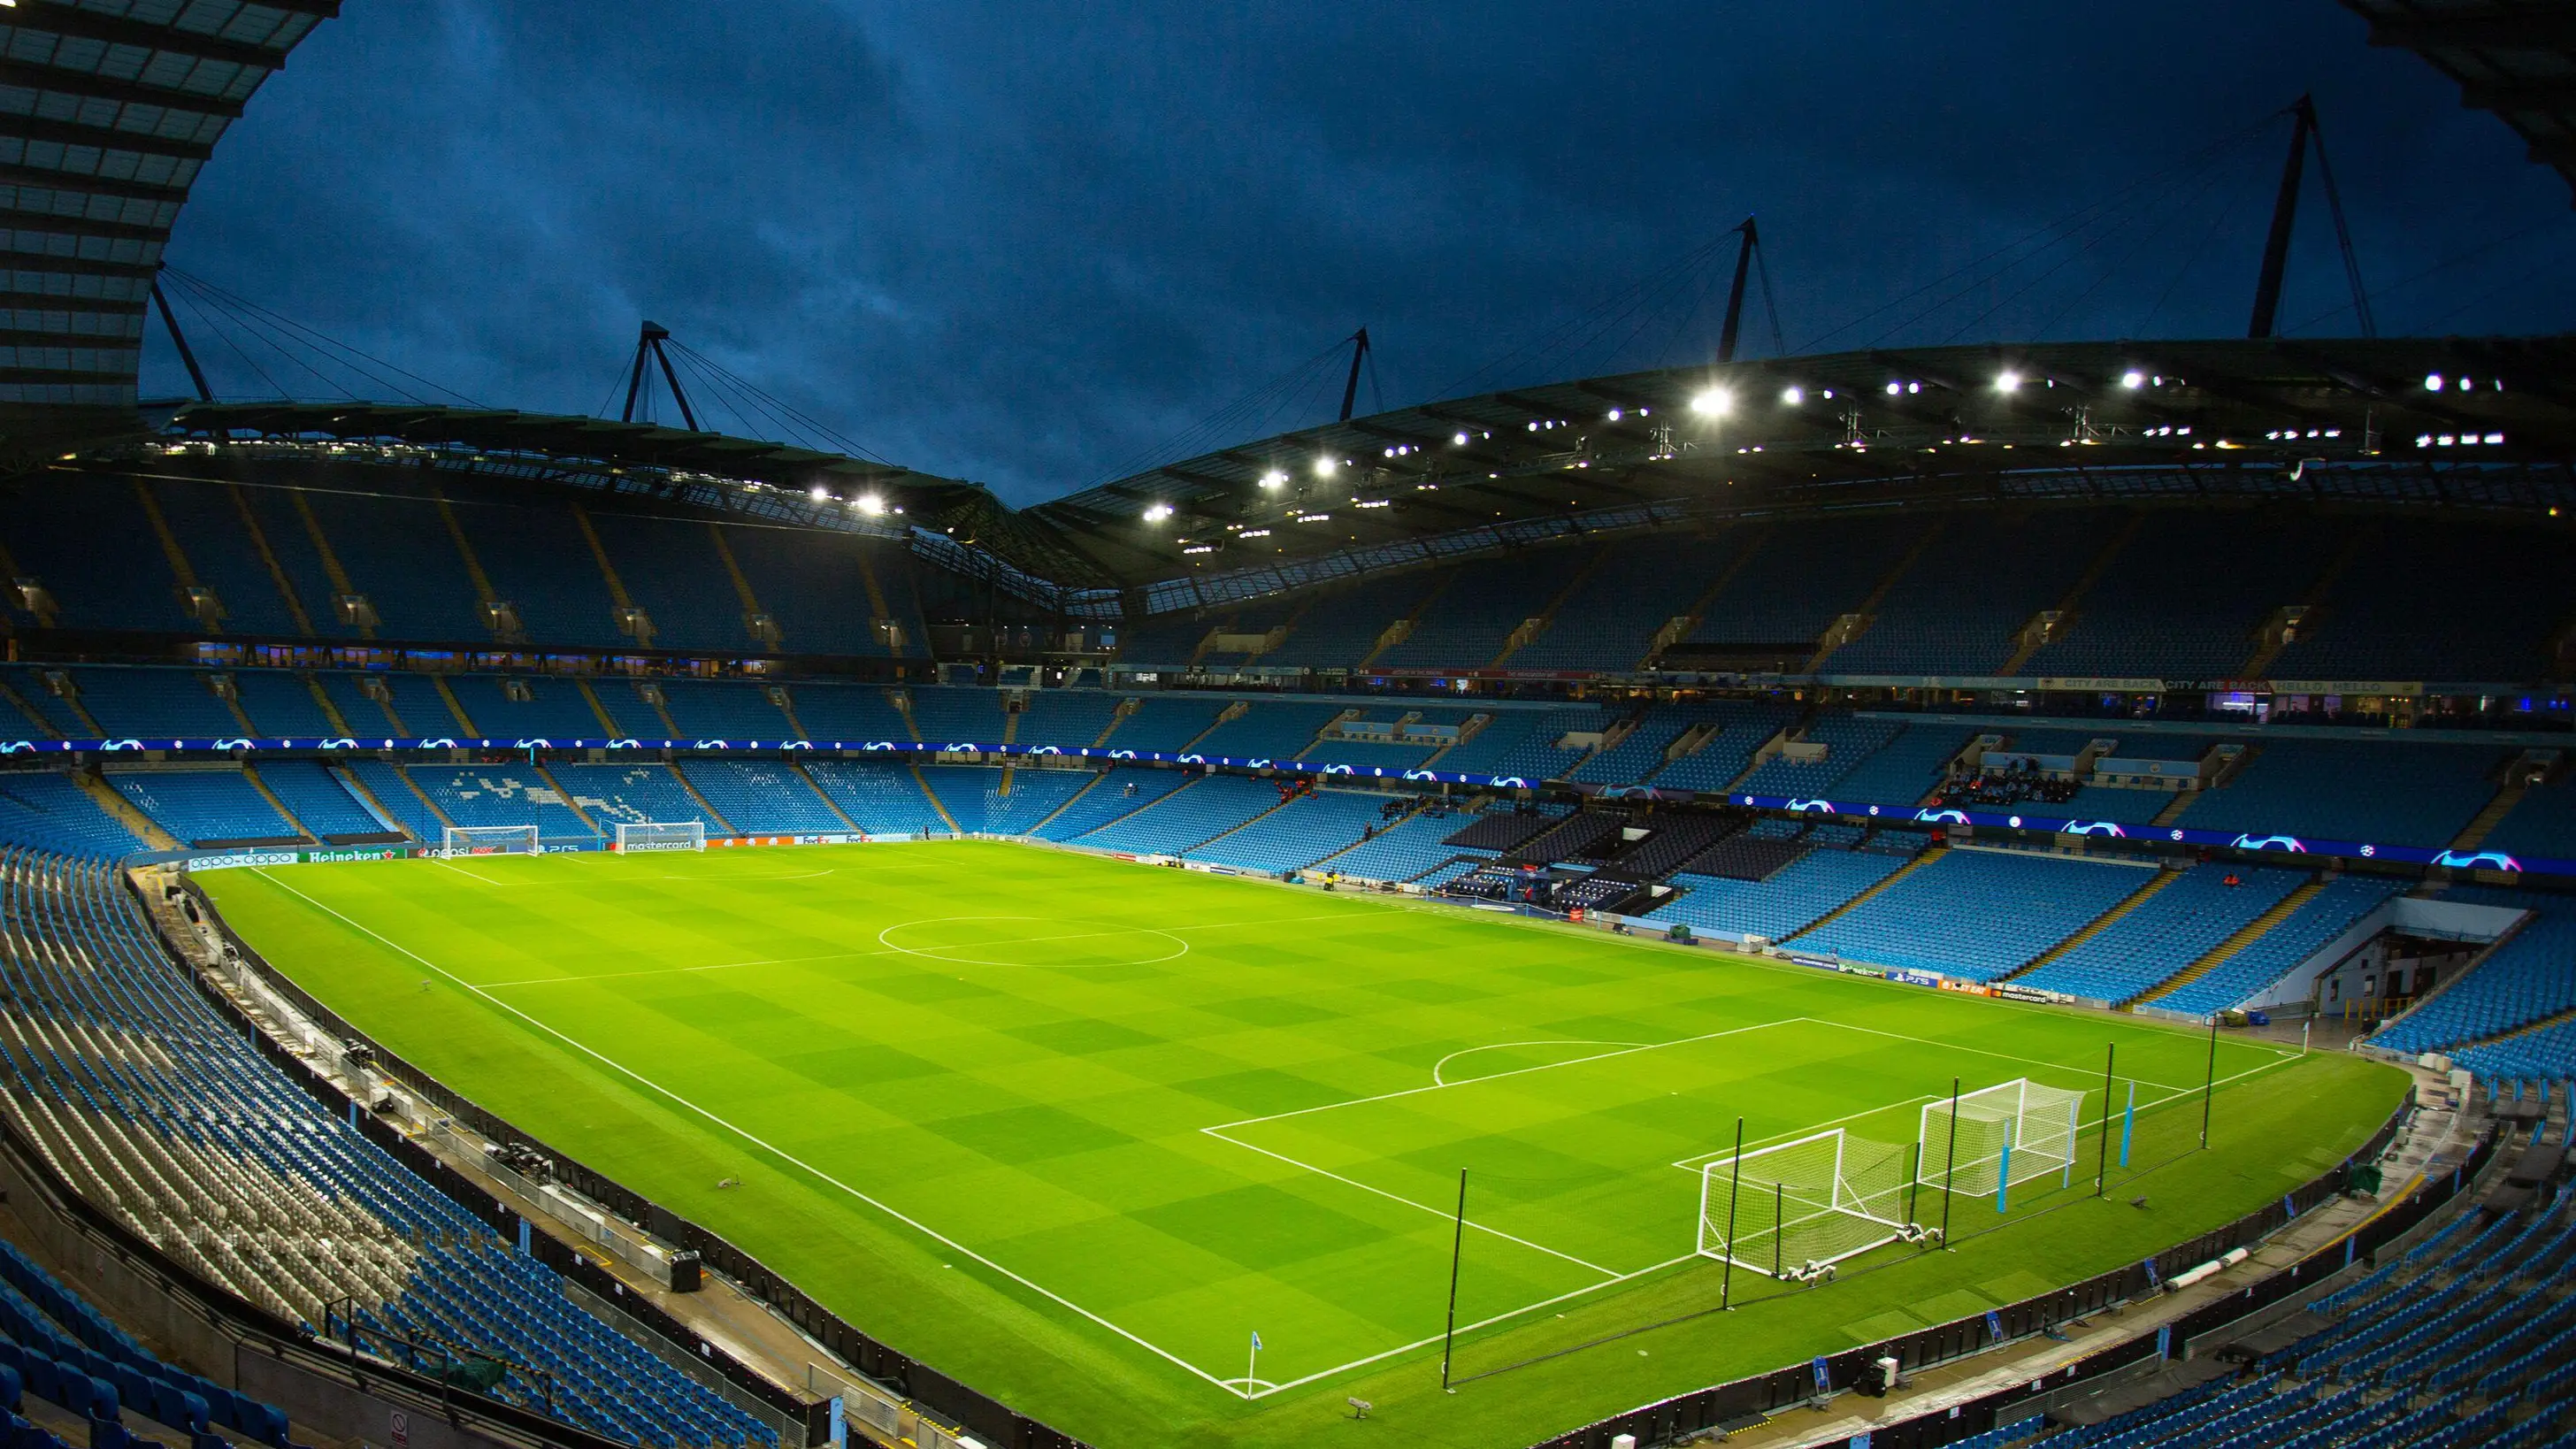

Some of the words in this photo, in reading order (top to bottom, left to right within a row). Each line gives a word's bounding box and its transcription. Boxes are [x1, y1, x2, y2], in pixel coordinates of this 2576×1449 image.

[2064, 678, 2091, 687] CITY
[2094, 679, 2120, 688] ARE
[2166, 680, 2195, 689] CITY
[803, 835, 830, 845] FedEx
[847, 834, 872, 843] FedEx
[627, 840, 691, 850] mastercard
[244, 855, 291, 866] oppo
[309, 850, 381, 863] Heineken
[1905, 975, 1929, 985] PS5
[2002, 992, 2046, 1003] mastercard
